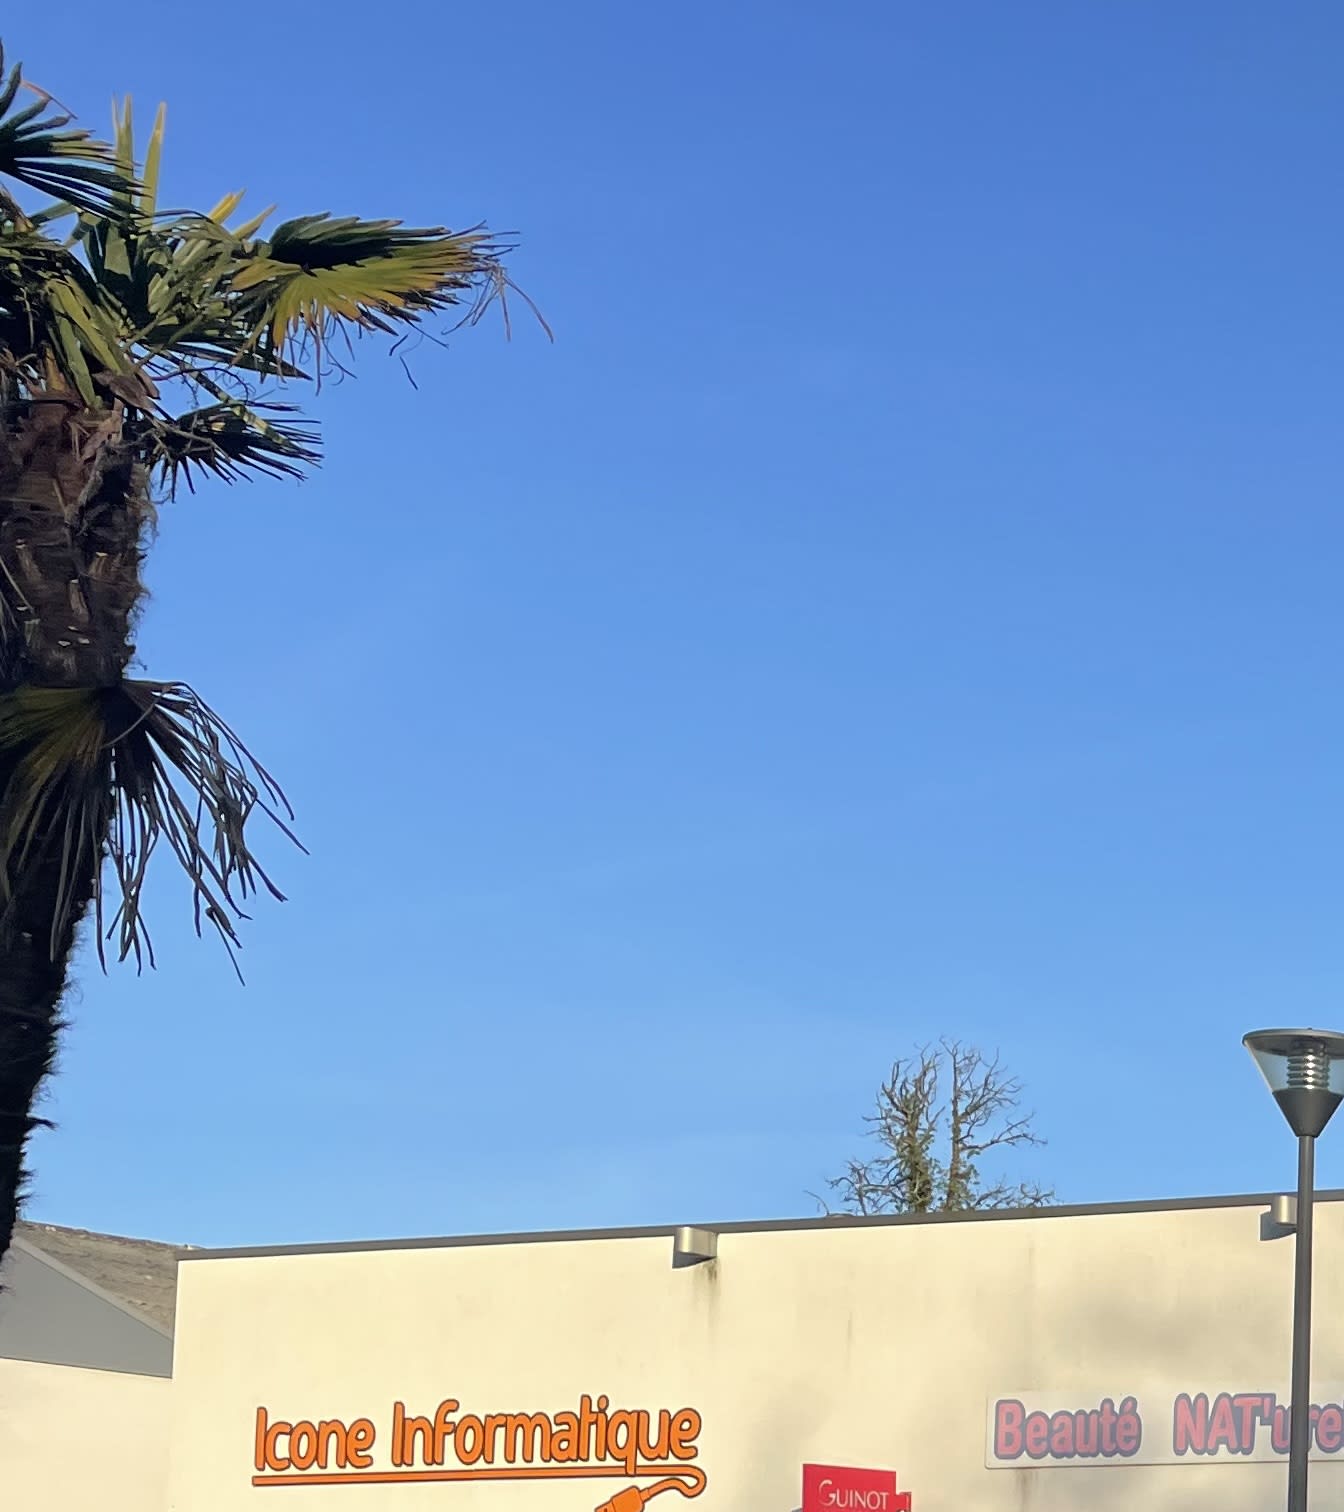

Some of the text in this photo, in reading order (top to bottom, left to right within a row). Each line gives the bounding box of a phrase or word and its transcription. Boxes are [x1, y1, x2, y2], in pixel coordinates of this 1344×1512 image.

[254, 1394, 700, 1476] Icone Informatique
[994, 1396, 1142, 1460] Beauté
[819, 1479, 889, 1511] GUINOT
